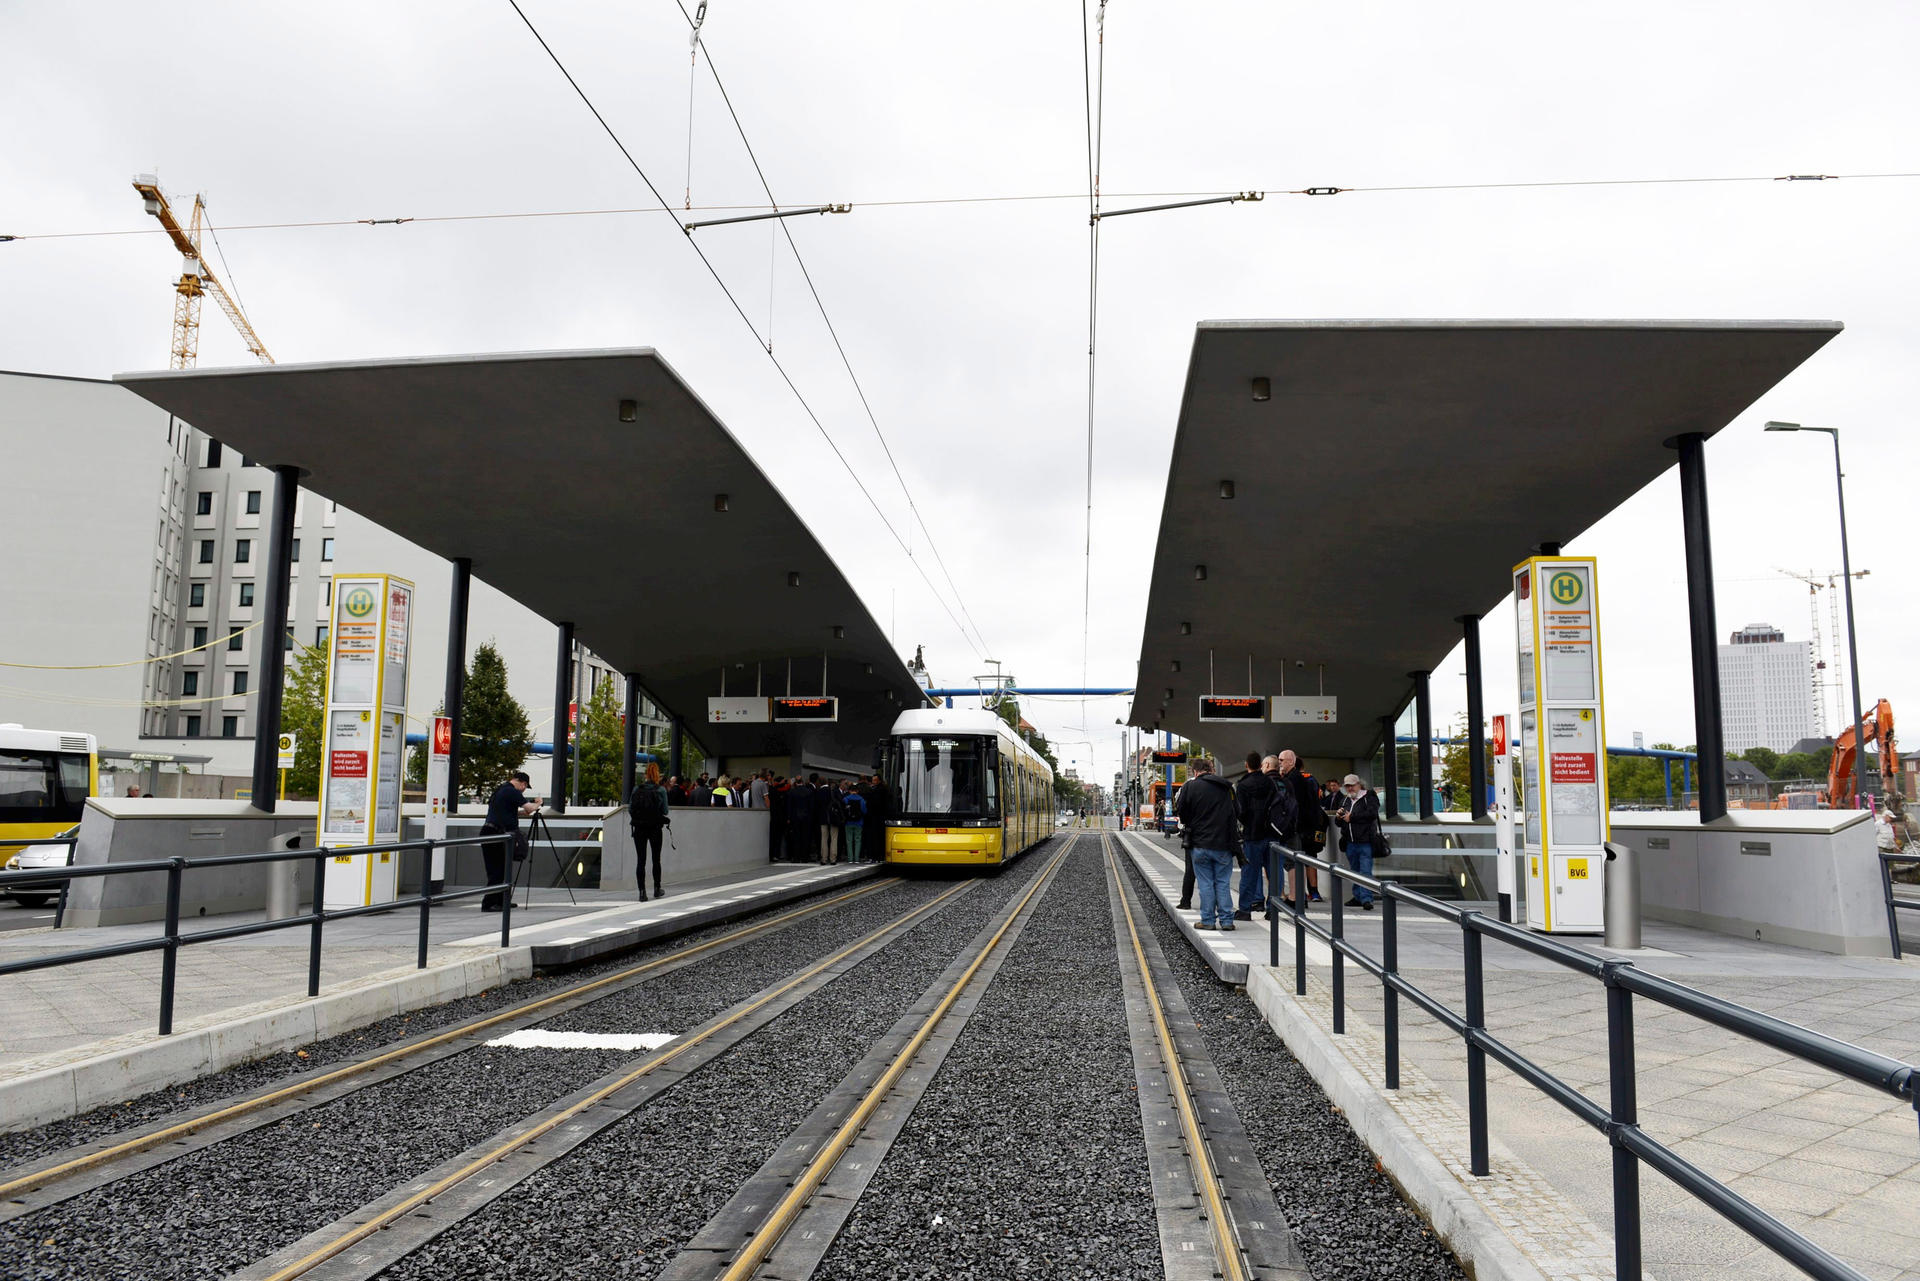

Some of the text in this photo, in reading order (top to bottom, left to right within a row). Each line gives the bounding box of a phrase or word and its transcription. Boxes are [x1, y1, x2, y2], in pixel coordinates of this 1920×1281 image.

[1558, 579, 1574, 597] H
[353, 594, 367, 610] H
[362, 712, 368, 721] 5
[1582, 711, 1588, 720] 4
[1570, 868, 1586, 877] BVG
